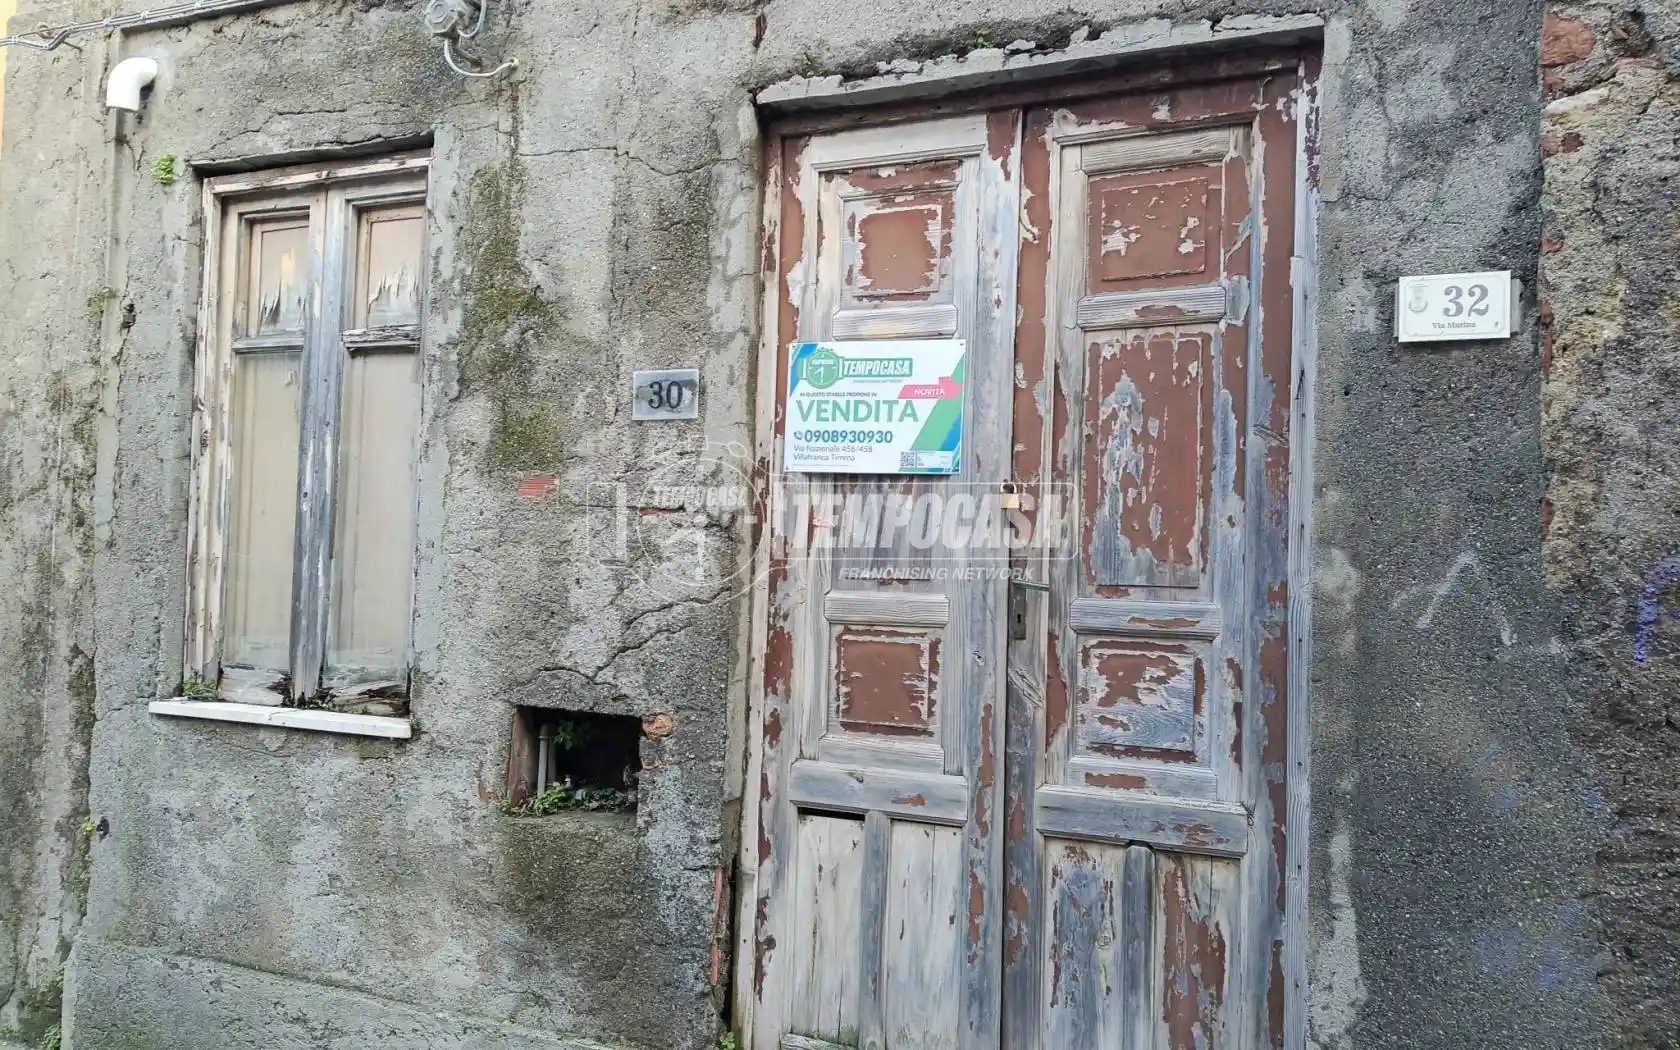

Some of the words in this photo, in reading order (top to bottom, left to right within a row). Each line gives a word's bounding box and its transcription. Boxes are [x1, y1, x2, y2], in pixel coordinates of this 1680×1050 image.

[1443, 284, 1489, 317] 32
[1447, 321, 1477, 329] Marina
[843, 360, 911, 375] TEMPOCASA
[648, 381, 683, 409] 30
[797, 400, 919, 423] VENDITA
[804, 430, 893, 443] 0908930930
[806, 445, 840, 453] Nazionale
[841, 445, 873, 453] 456/458
[793, 453, 829, 461] Villafranca
